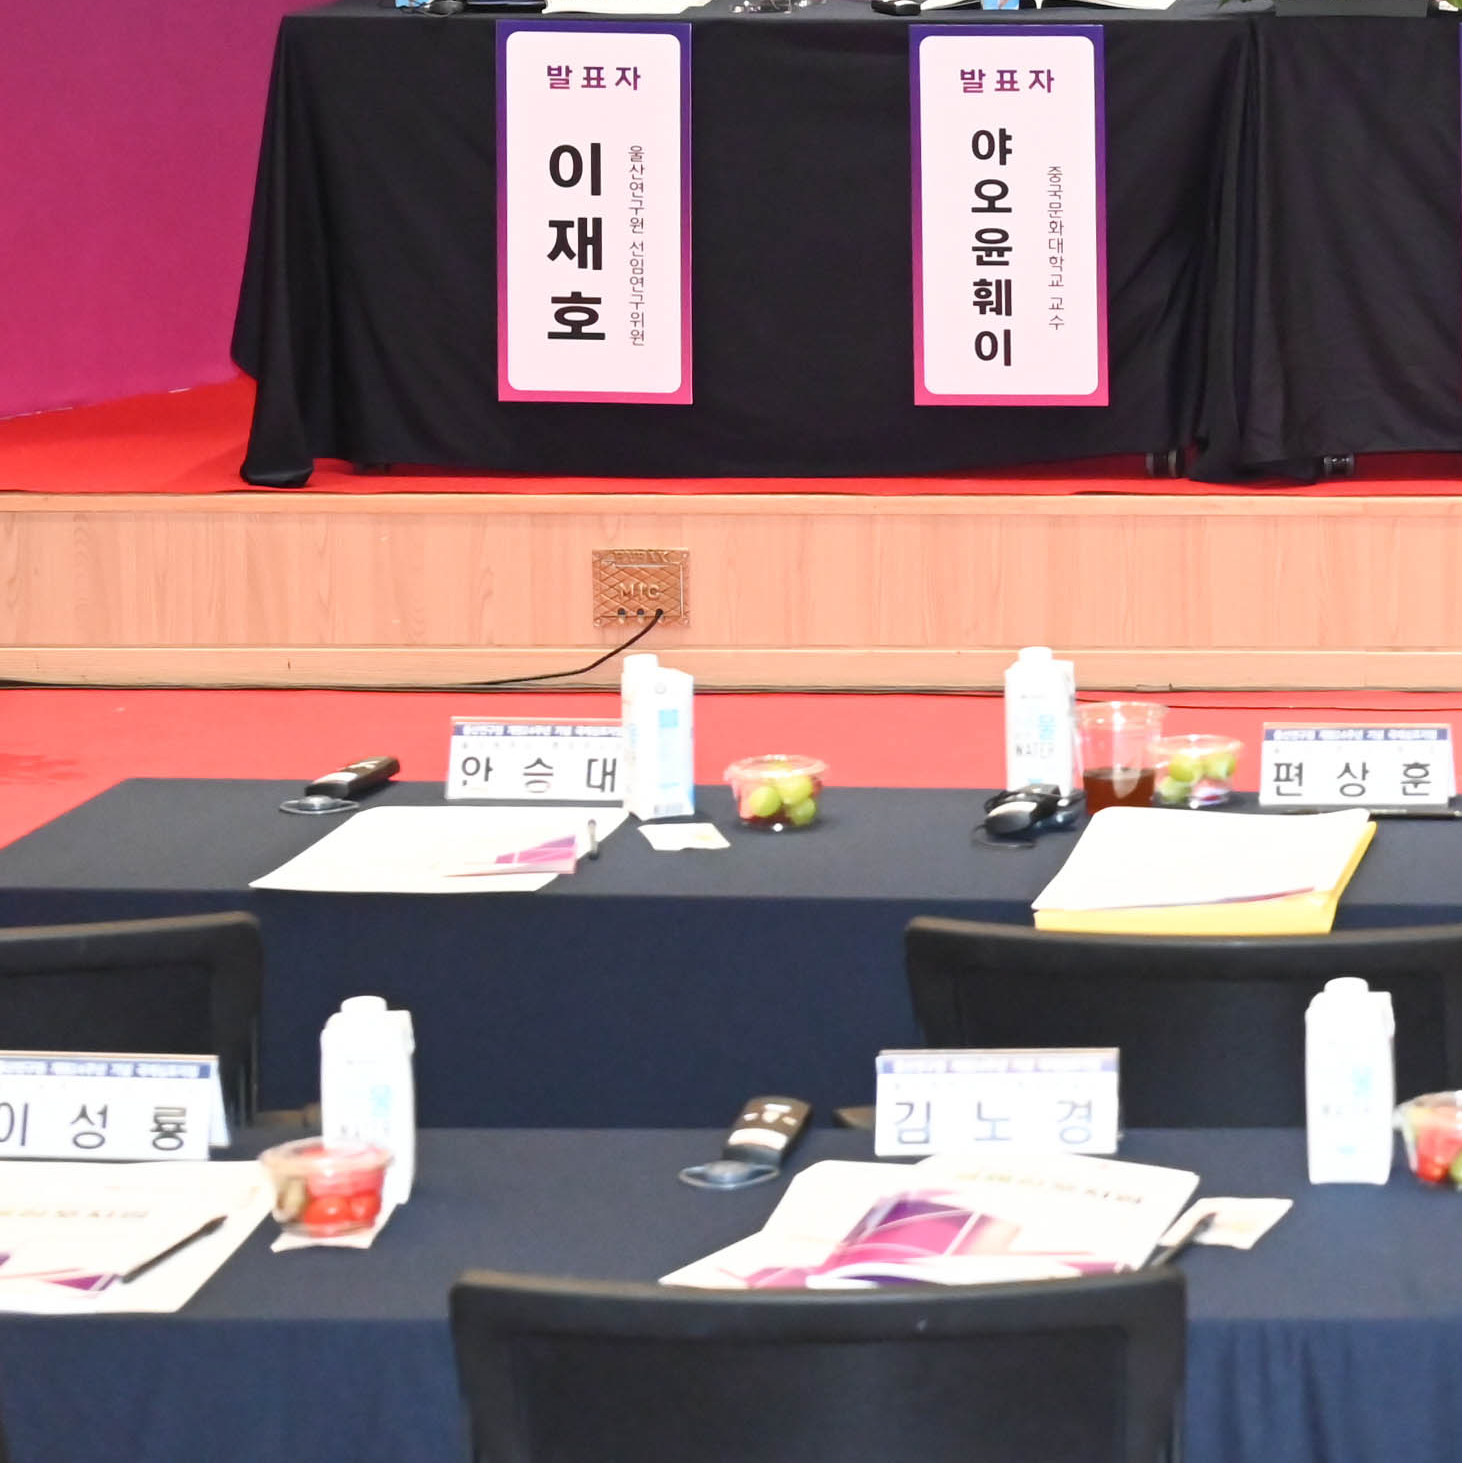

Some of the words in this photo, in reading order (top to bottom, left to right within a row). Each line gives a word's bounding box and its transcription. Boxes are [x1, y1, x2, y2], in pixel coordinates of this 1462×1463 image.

[547, 66, 641, 90] 발표자
[960, 69, 1054, 93] 발표자
[629, 145, 644, 234] 울산연구원
[547, 143, 605, 340] 이재호
[971, 128, 1012, 366] 야오윤훼이
[1048, 166, 1064, 287] 중국문화대학교
[629, 241, 644, 346] 선임연구위원
[1049, 297, 1064, 330] 교수
[617, 580, 664, 602] MIC
[1274, 762, 1430, 797] 편상훈
[0, 1102, 187, 1151] 이성룡
[895, 1100, 1092, 1145] 김노경
